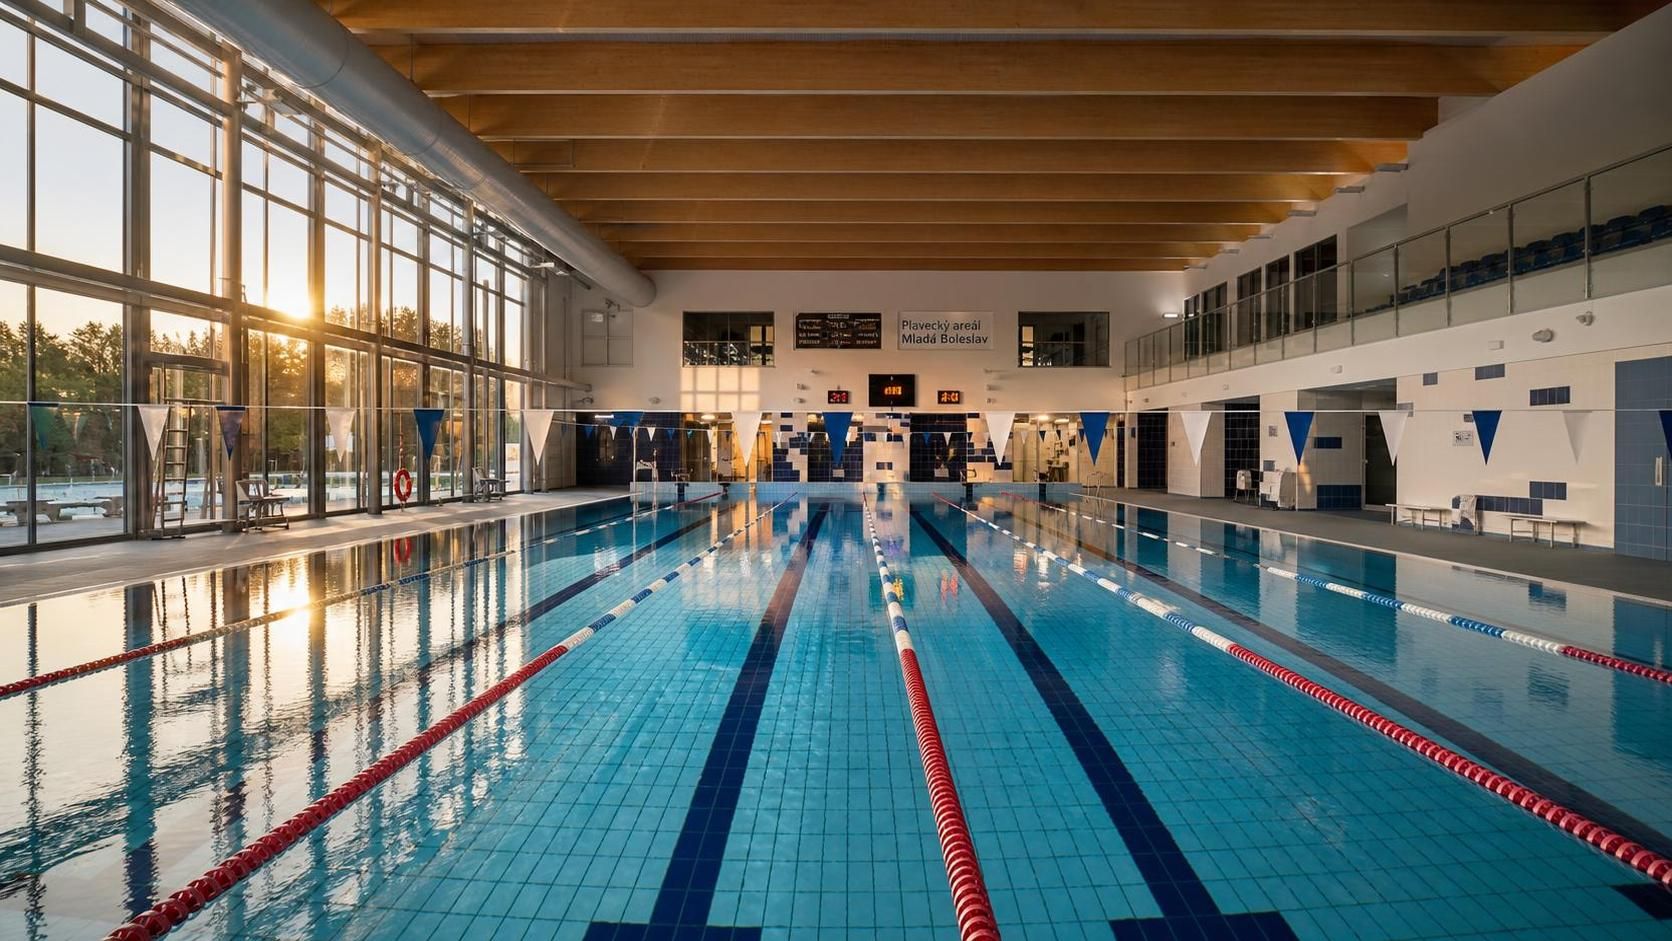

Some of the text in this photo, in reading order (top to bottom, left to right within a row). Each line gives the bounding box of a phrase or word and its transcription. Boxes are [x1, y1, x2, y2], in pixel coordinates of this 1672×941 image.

[902, 320, 981, 332] Plavecký areál
[902, 334, 989, 344] Mladá Boleslav
